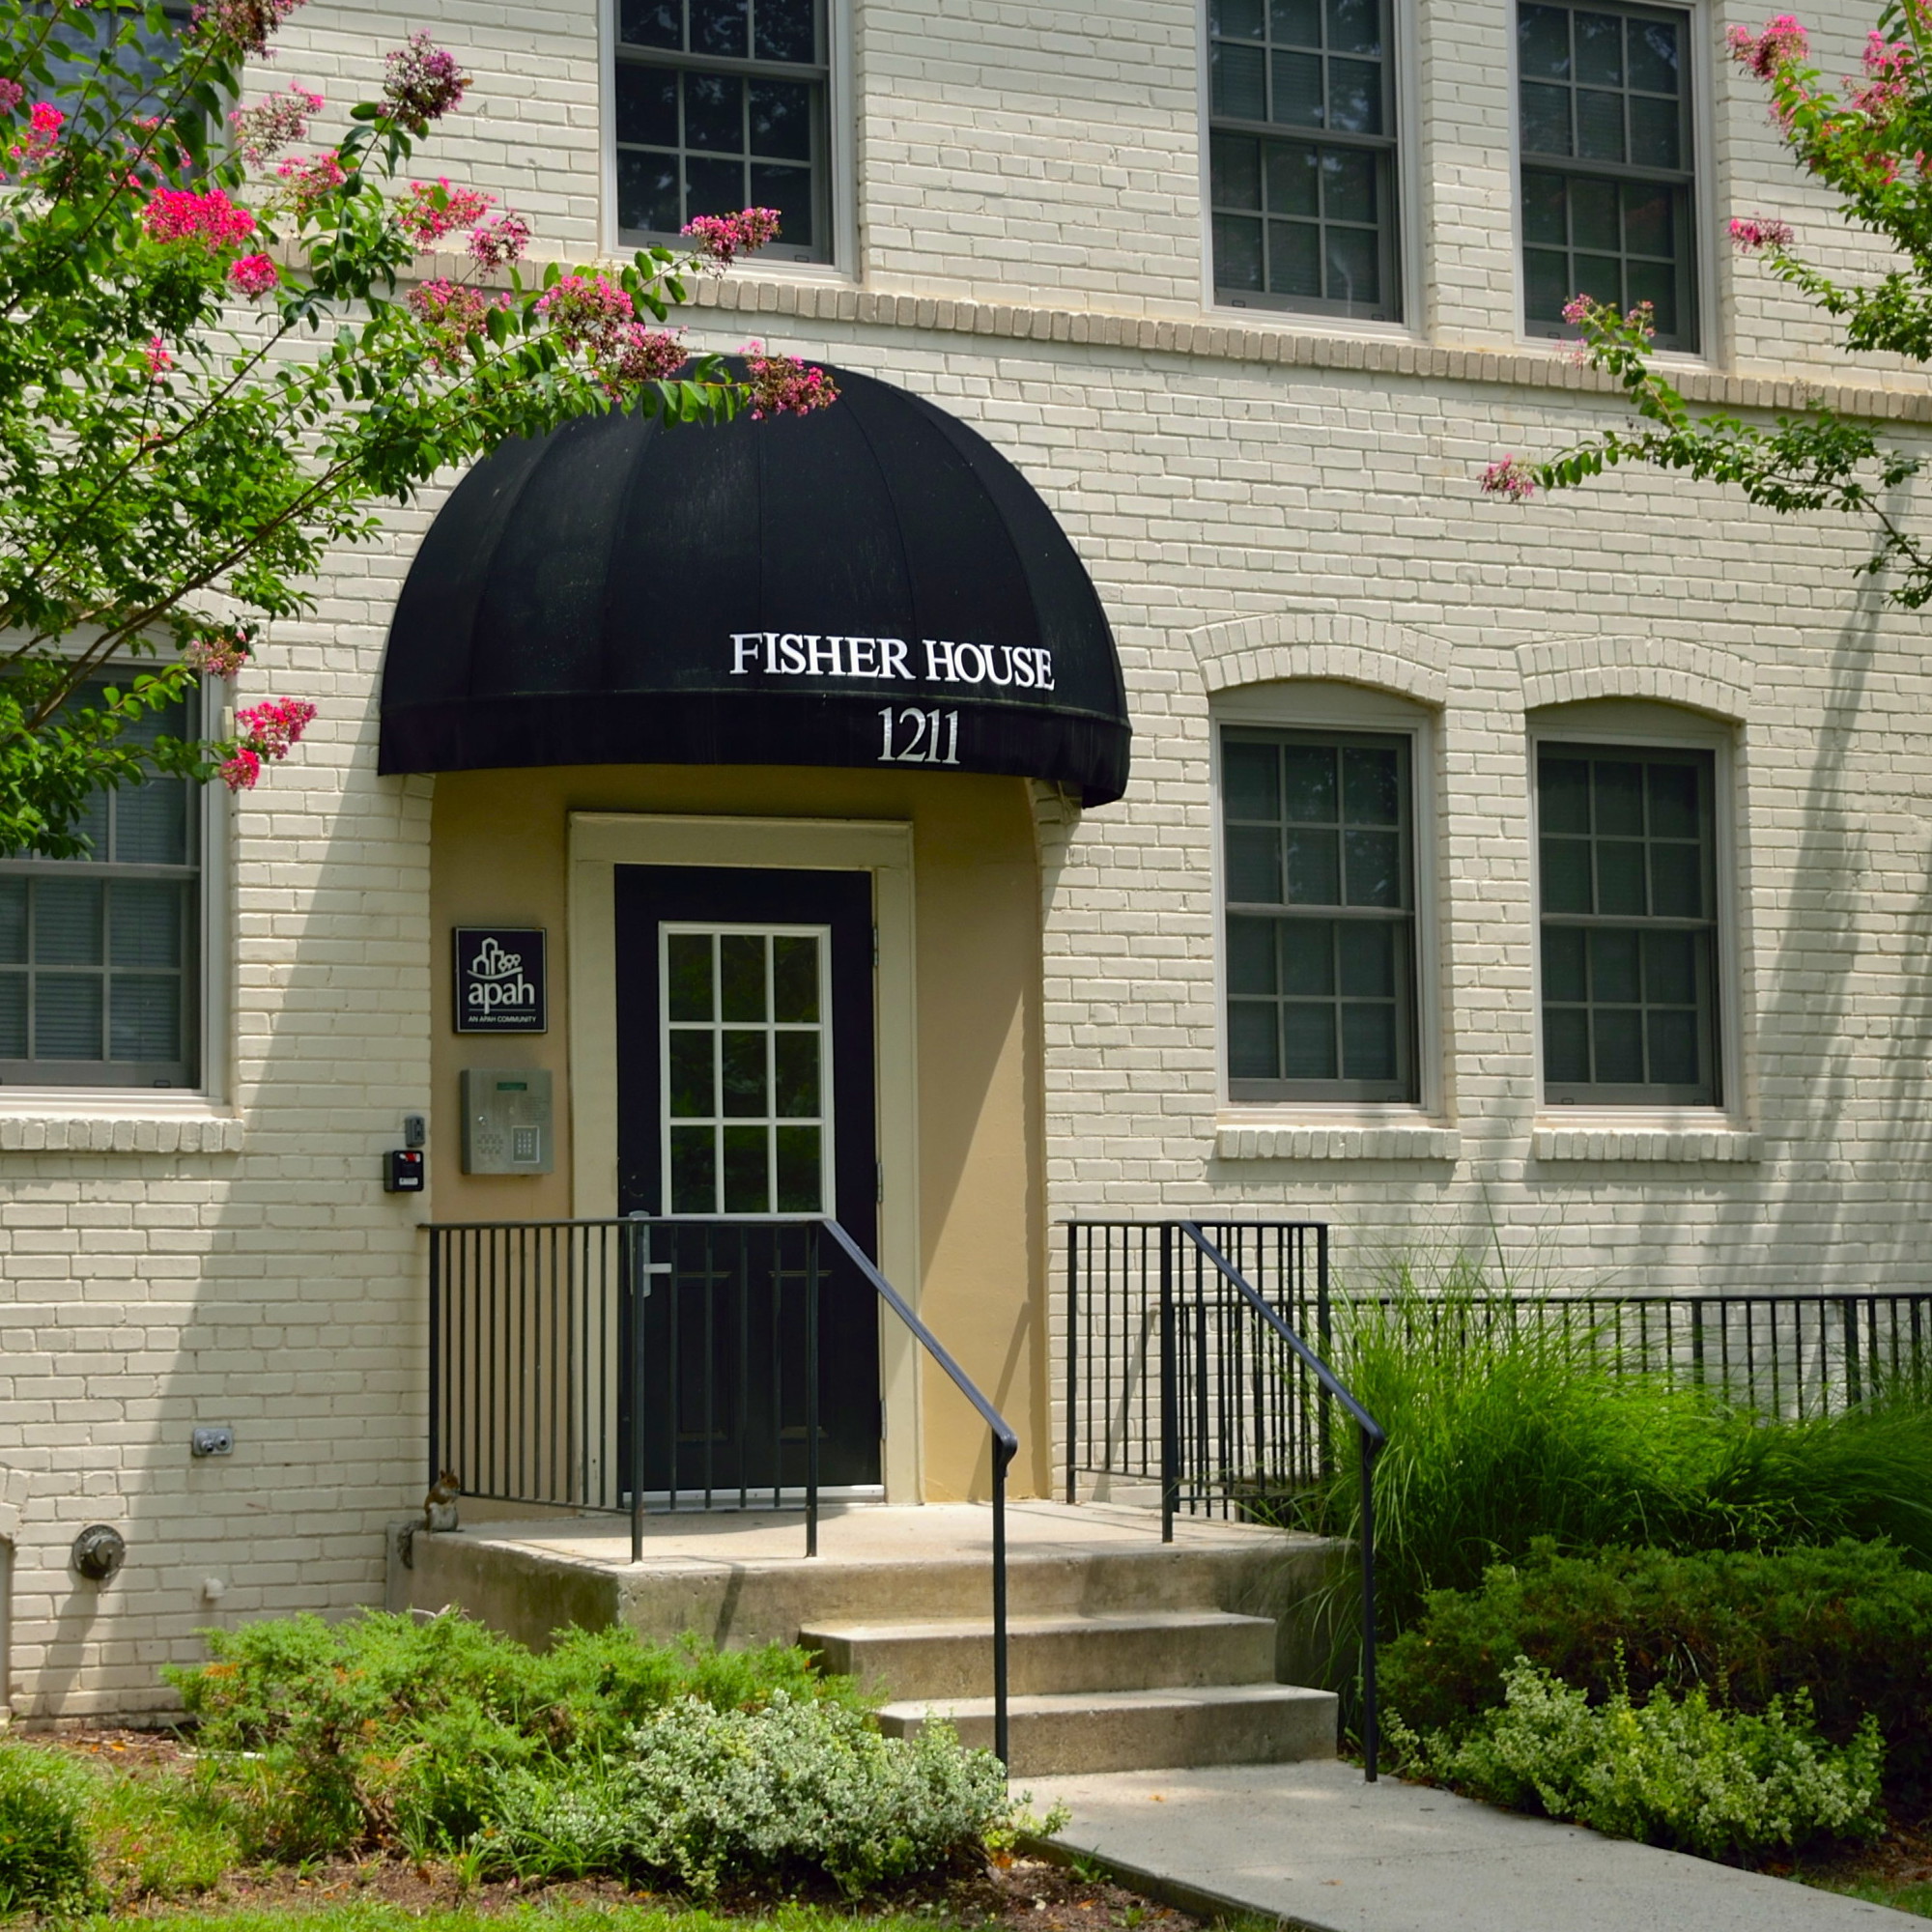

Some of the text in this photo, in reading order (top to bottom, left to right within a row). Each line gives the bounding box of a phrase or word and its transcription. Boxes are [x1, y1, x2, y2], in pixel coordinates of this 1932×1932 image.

[729, 632, 1055, 691] FISHER HOUSE
[877, 706, 960, 764] 1211
[468, 973, 535, 1014] apah
